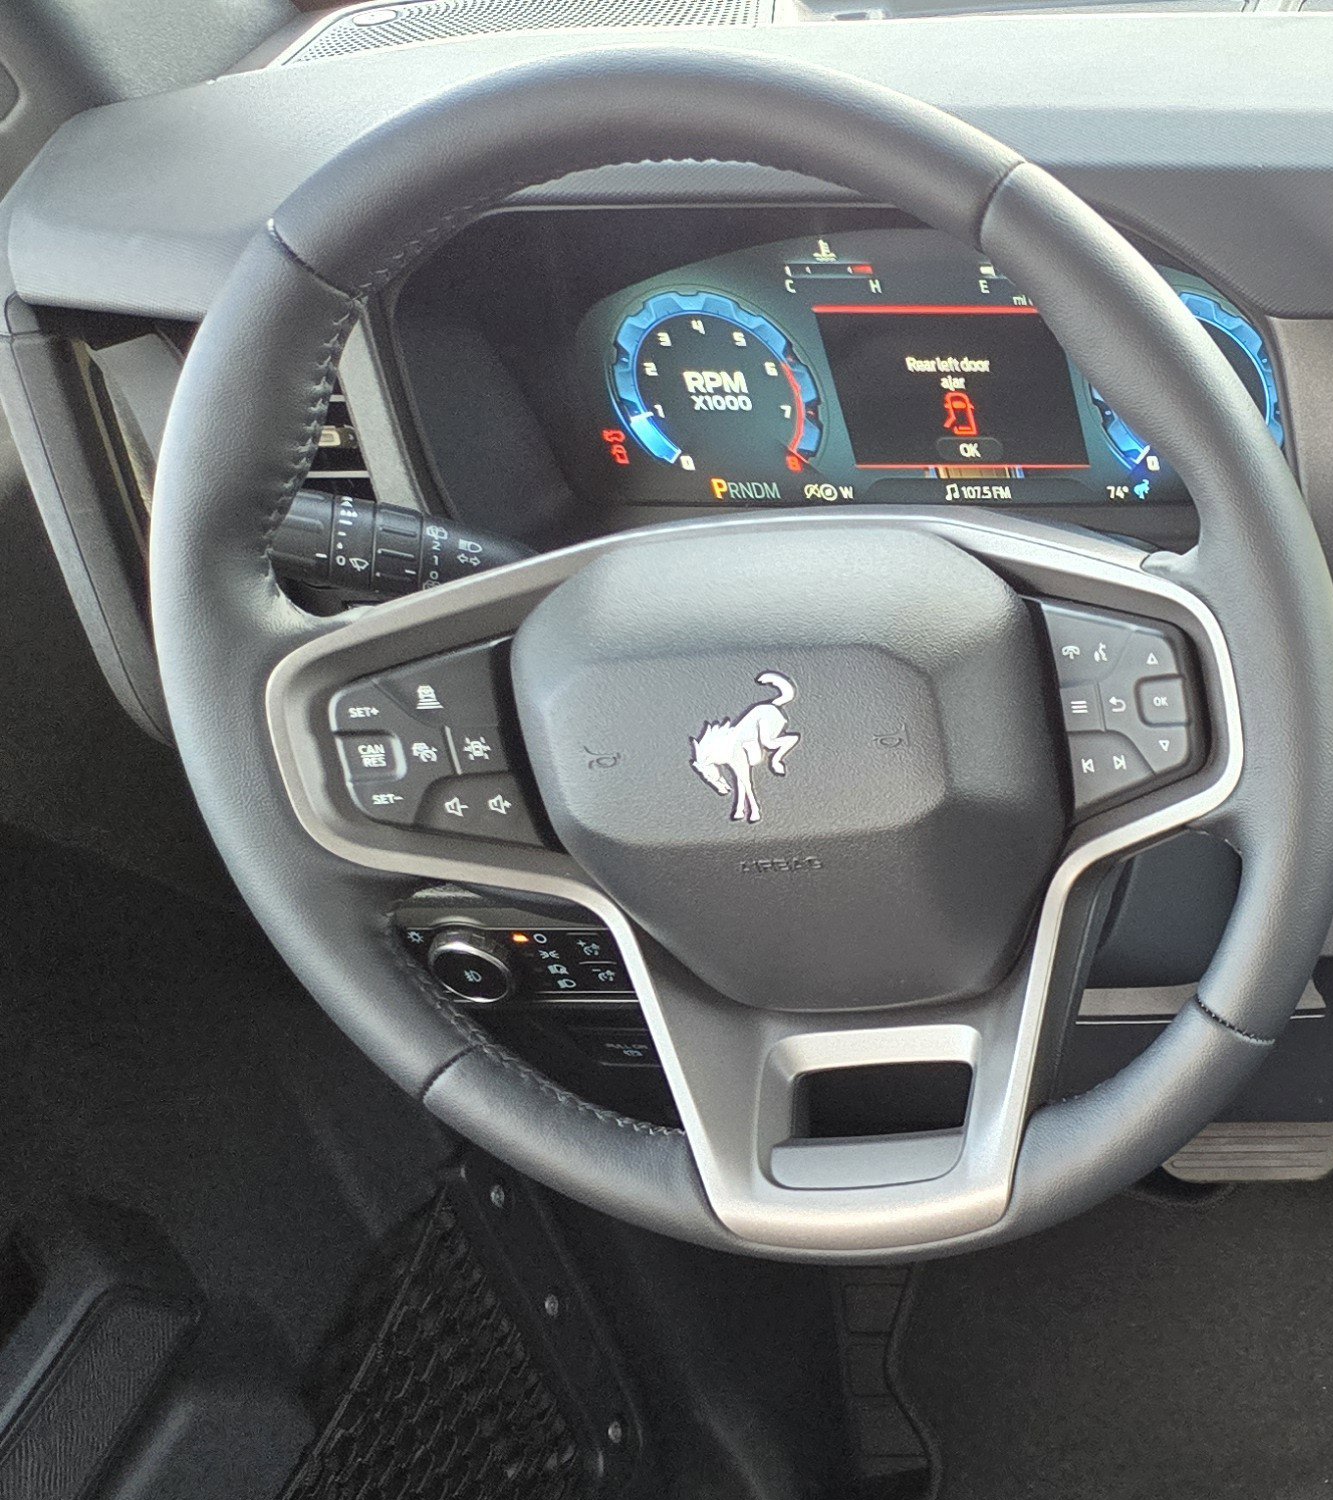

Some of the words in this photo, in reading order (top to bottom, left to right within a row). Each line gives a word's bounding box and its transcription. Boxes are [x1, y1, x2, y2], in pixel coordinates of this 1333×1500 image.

[785, 280, 796, 294] C
[870, 280, 882, 293] H
[979, 280, 990, 294] E
[692, 320, 705, 335] 4
[658, 332, 672, 346] 3
[732, 332, 746, 346] 5
[644, 362, 659, 376] 2
[764, 362, 778, 376] 6
[905, 356, 937, 372] Rear
[936, 356, 961, 372] left
[960, 356, 990, 372] door
[683, 371, 749, 394] RPM
[940, 374, 965, 391] ajar
[691, 395, 752, 411] X1000
[654, 404, 666, 418] 1
[780, 405, 792, 419] 7
[960, 443, 981, 458] OK
[840, 486, 854, 499] W
[962, 486, 991, 499] 107.5
[993, 486, 1012, 499] FM
[432, 541, 442, 551] 2
[1153, 696, 1169, 707] OK
[349, 707, 379, 718] SET+
[358, 744, 386, 755] CAN
[362, 756, 387, 768] RES
